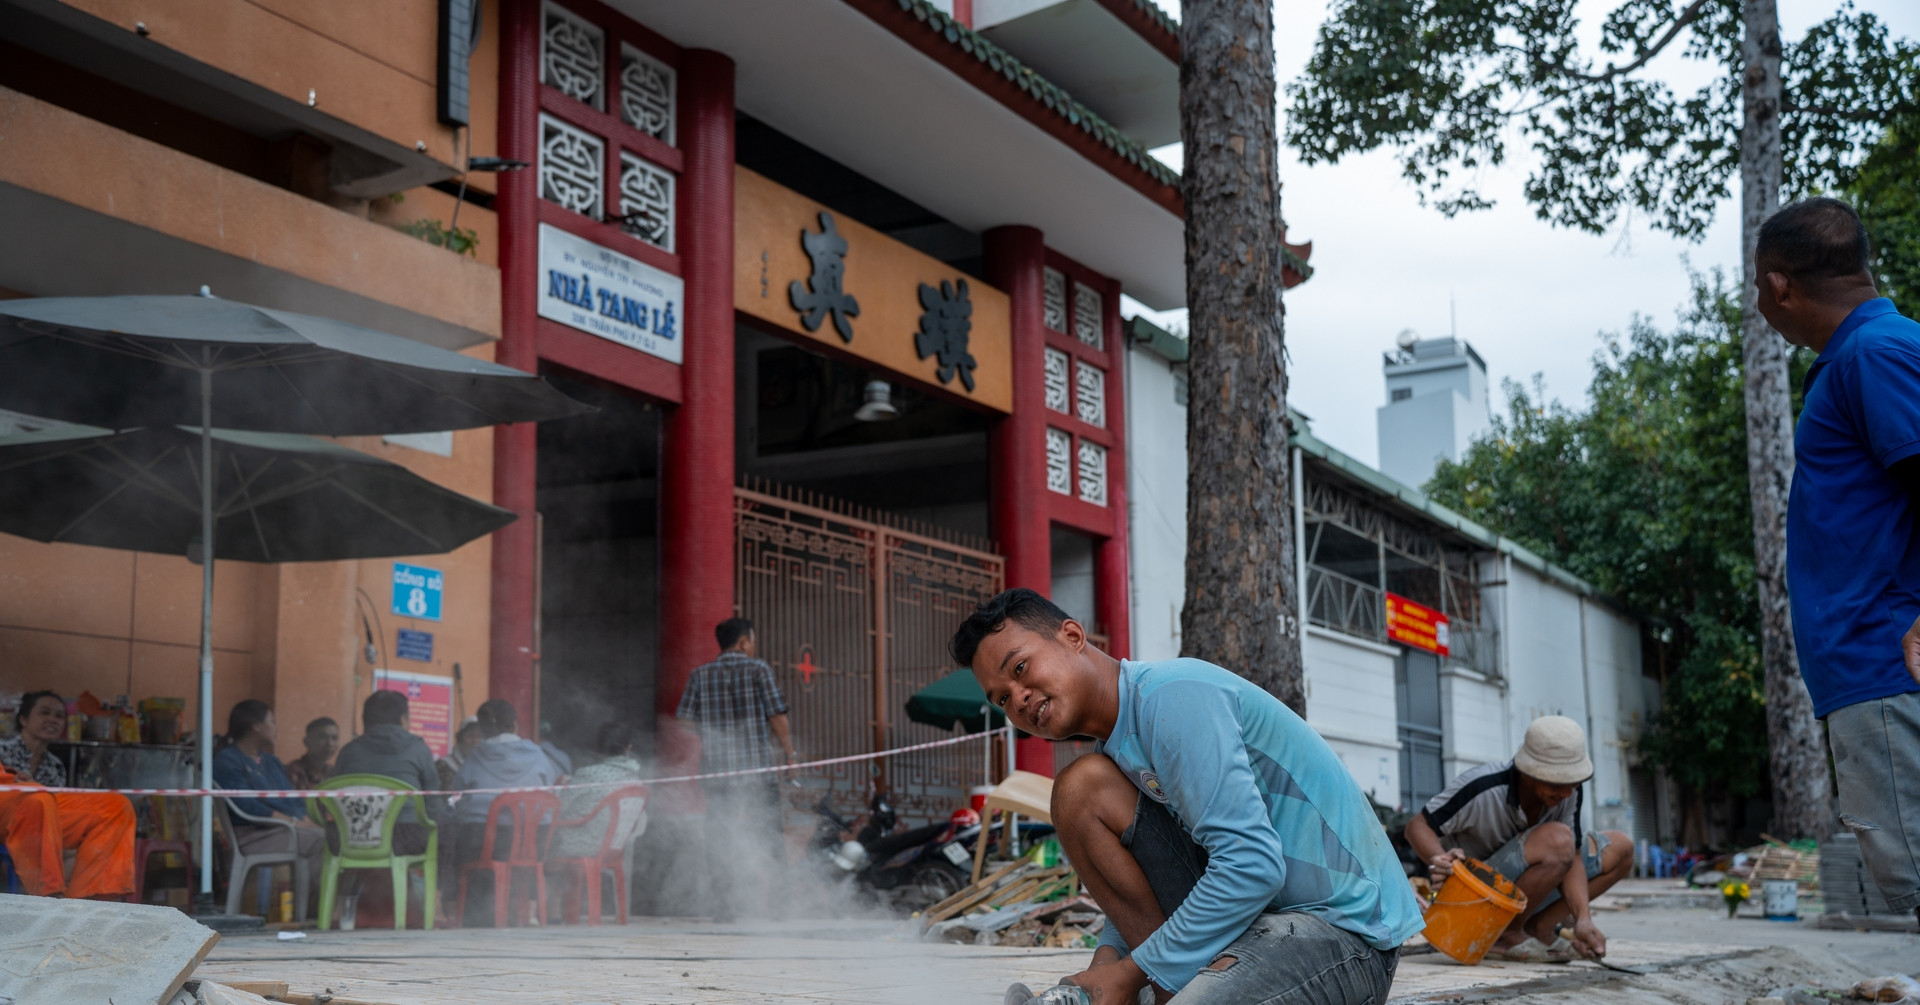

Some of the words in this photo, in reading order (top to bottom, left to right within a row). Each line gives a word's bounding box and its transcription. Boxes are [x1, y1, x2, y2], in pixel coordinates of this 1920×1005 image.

[548, 268, 595, 311] NHÀ
[597, 287, 649, 330] TANG
[407, 588, 428, 616] 8
[1276, 614, 1297, 639] 13
